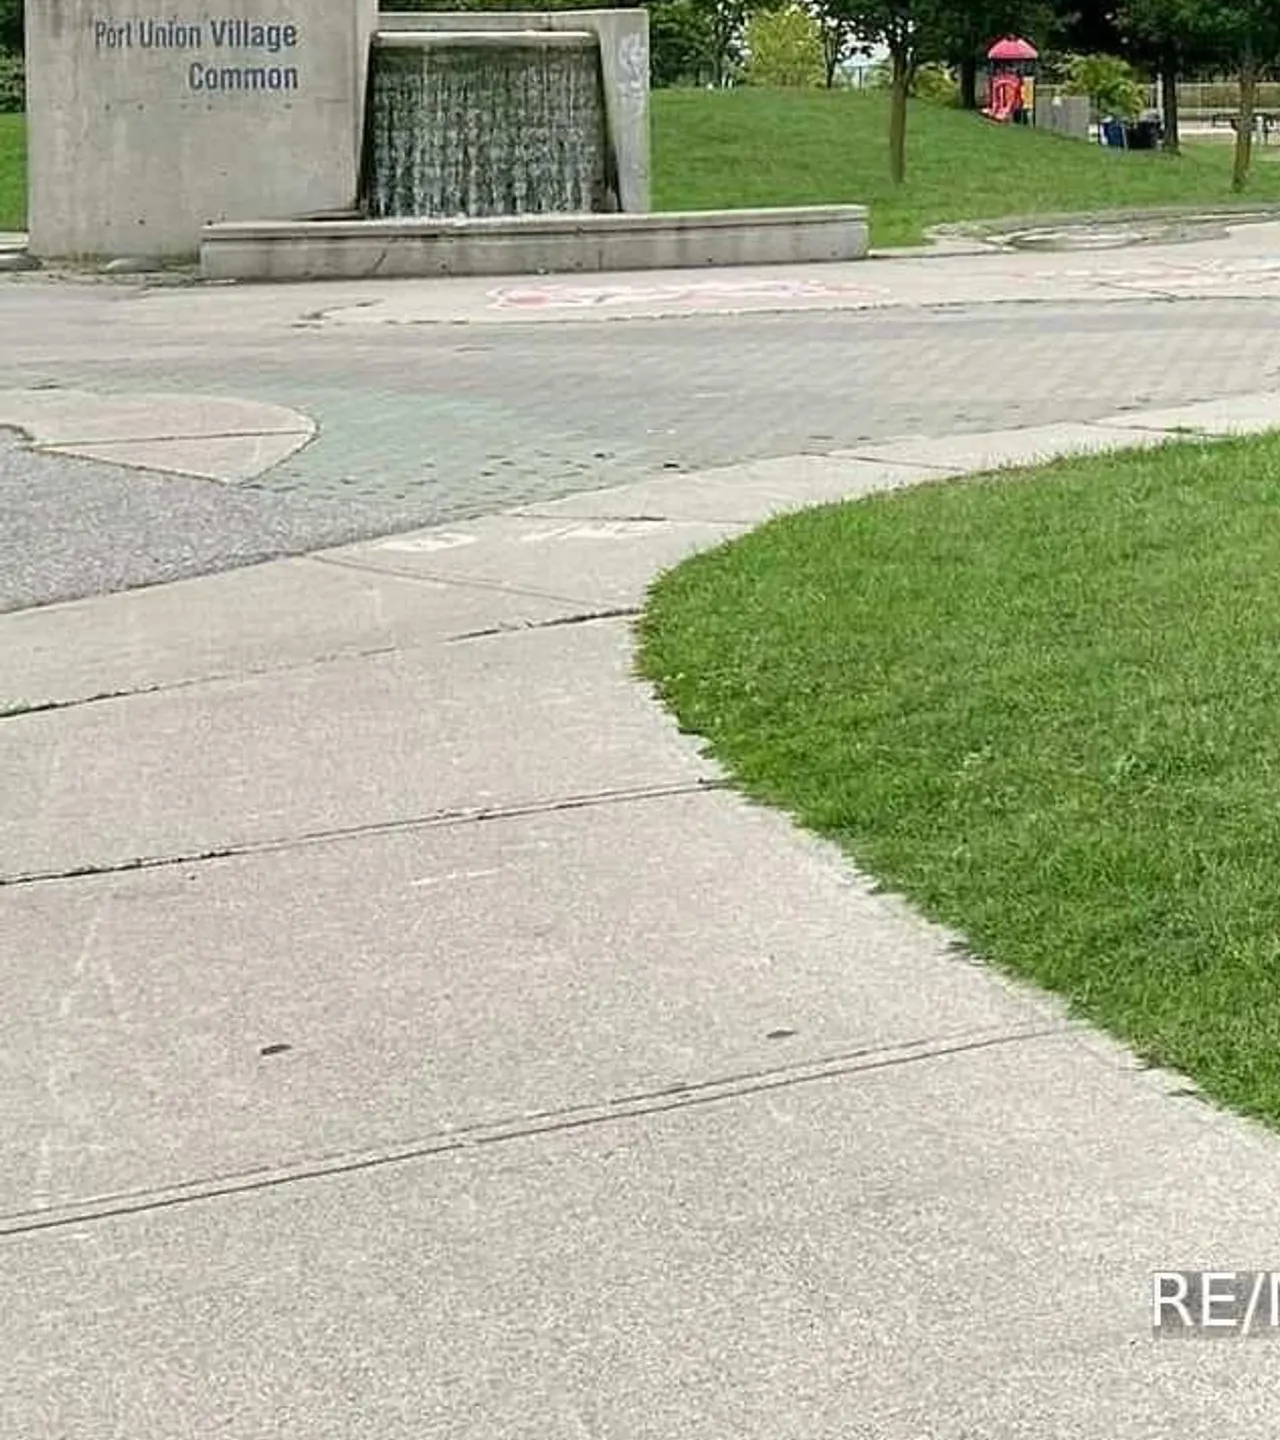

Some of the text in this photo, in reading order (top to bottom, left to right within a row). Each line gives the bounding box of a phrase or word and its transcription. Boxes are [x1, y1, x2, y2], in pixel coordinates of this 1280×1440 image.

[95, 19, 298, 53] Port Union Village
[188, 61, 299, 90] Common
